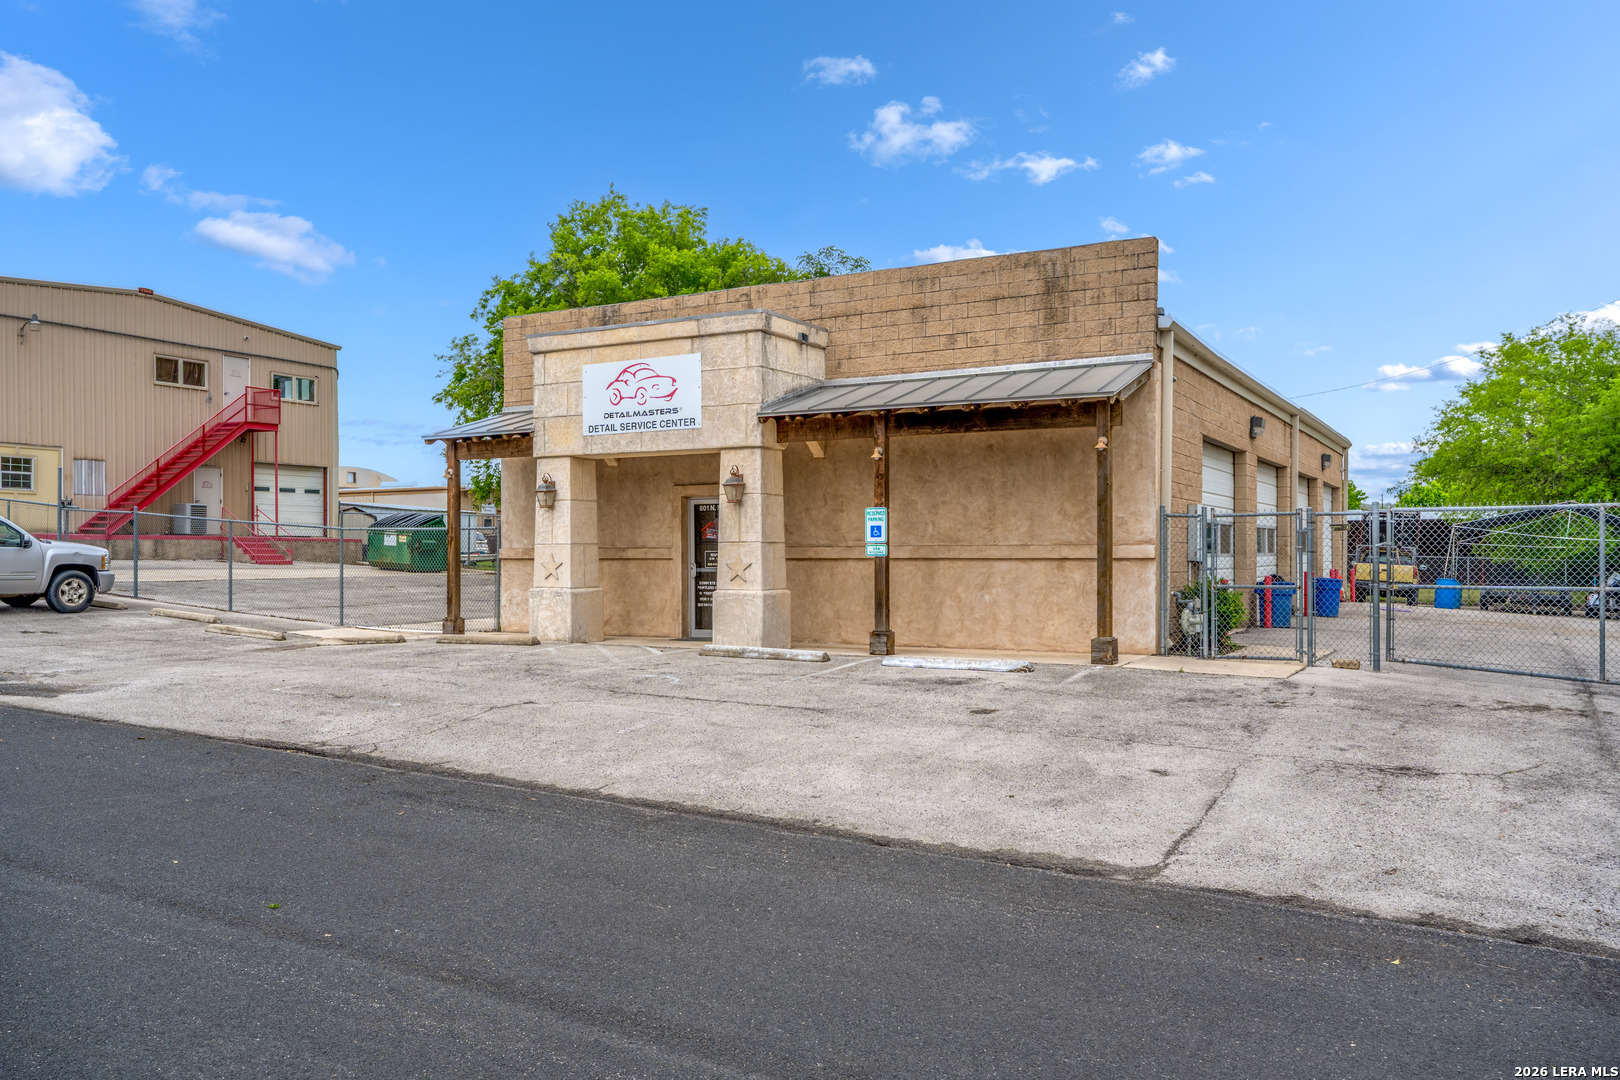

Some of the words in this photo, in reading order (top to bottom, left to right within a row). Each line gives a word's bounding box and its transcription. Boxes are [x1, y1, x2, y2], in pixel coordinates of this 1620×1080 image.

[603, 407, 679, 419] DETAILMASTERS
[588, 423, 618, 434] DETAIL
[620, 420, 657, 431] SERVICE
[660, 418, 696, 428] CENTER
